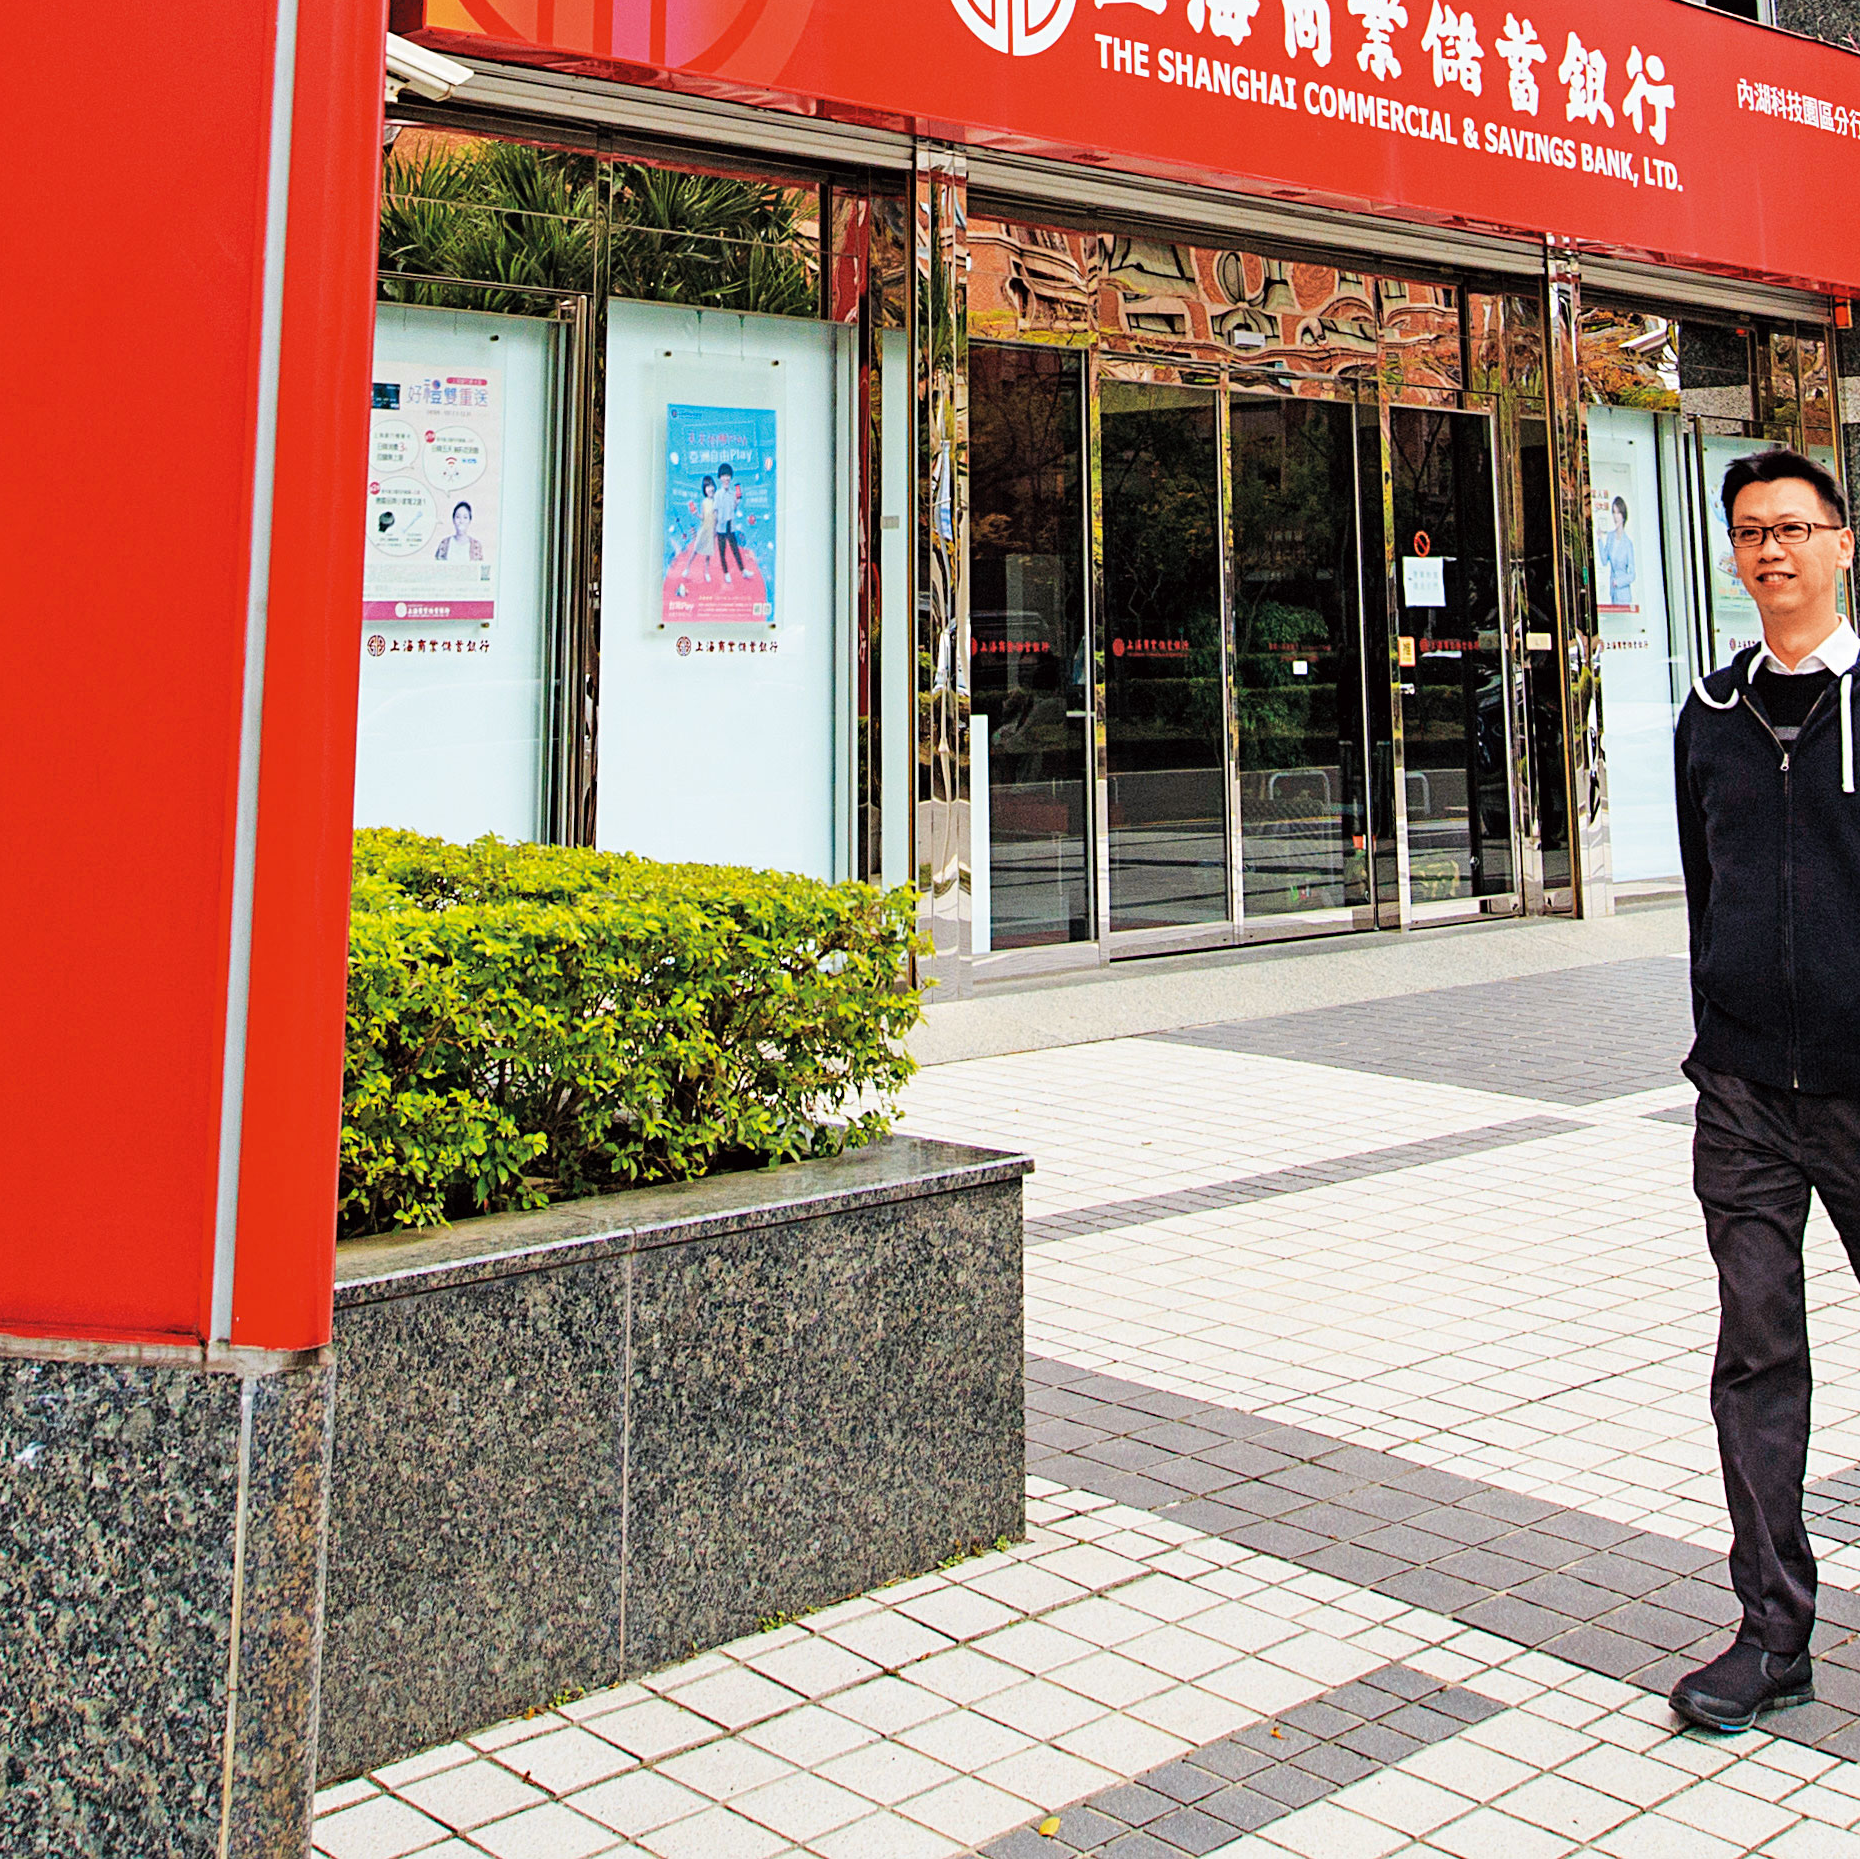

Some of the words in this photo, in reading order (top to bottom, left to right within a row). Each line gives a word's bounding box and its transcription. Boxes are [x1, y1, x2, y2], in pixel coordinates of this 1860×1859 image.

[1094, 33, 1150, 78] THE
[1157, 47, 1298, 111] SHANGHAI
[1303, 81, 1458, 145] COMMERCIAL
[1462, 117, 1481, 150] &
[1484, 122, 1577, 170] SAVINGS
[1580, 142, 1639, 188] BANK,
[1643, 156, 1684, 193] LTD.
[390, 639, 490, 653] 上海商業儲蓄銀行
